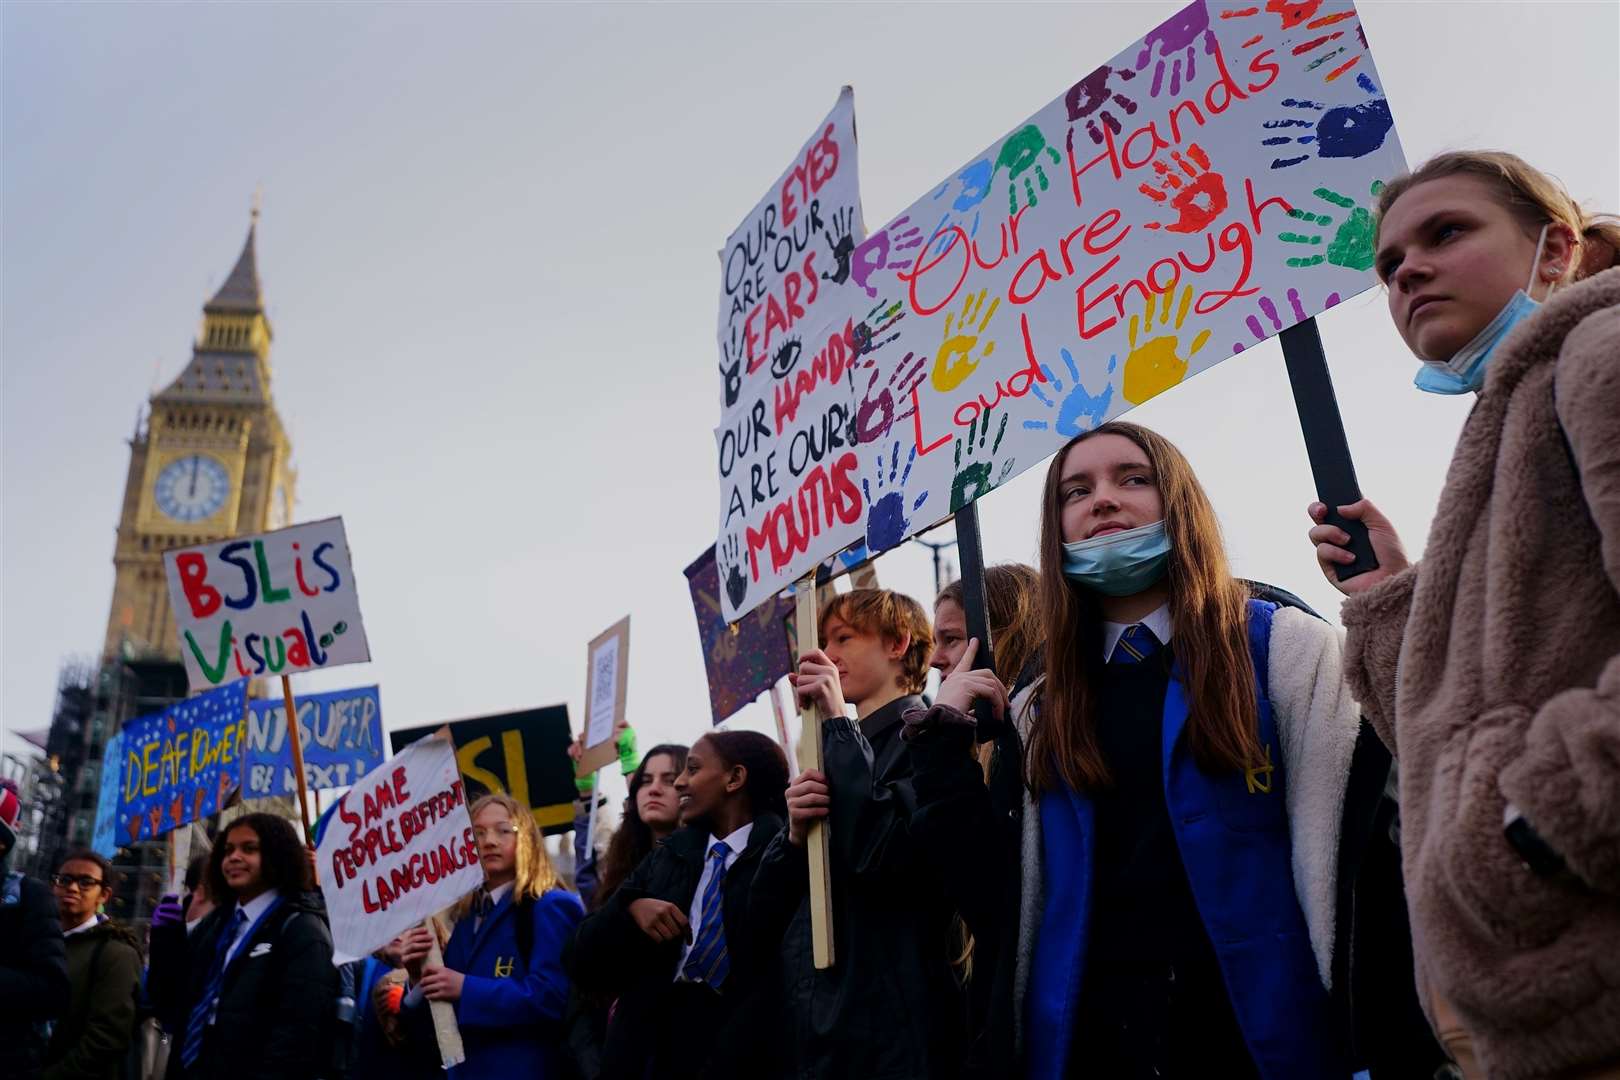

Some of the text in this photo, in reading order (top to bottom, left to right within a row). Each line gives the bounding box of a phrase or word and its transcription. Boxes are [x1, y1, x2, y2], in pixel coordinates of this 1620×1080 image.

[726, 122, 840, 296] OUR EYES
[897, 38, 1280, 316] Our Hands
[729, 198, 824, 327] ARE OUR
[745, 251, 818, 375] EARS
[912, 178, 1297, 456] Loud Enough
[1008, 208, 1131, 304] are
[719, 314, 857, 478] OUR HANDS
[725, 402, 847, 529] ARE OUR
[746, 451, 863, 583] MOUTHS
[176, 539, 341, 619] BSL is
[184, 610, 328, 684] Visual
[125, 732, 188, 804] DEAF
[250, 763, 275, 793] BE
[339, 766, 411, 842] SAME
[363, 827, 479, 914] LANGUAGE
